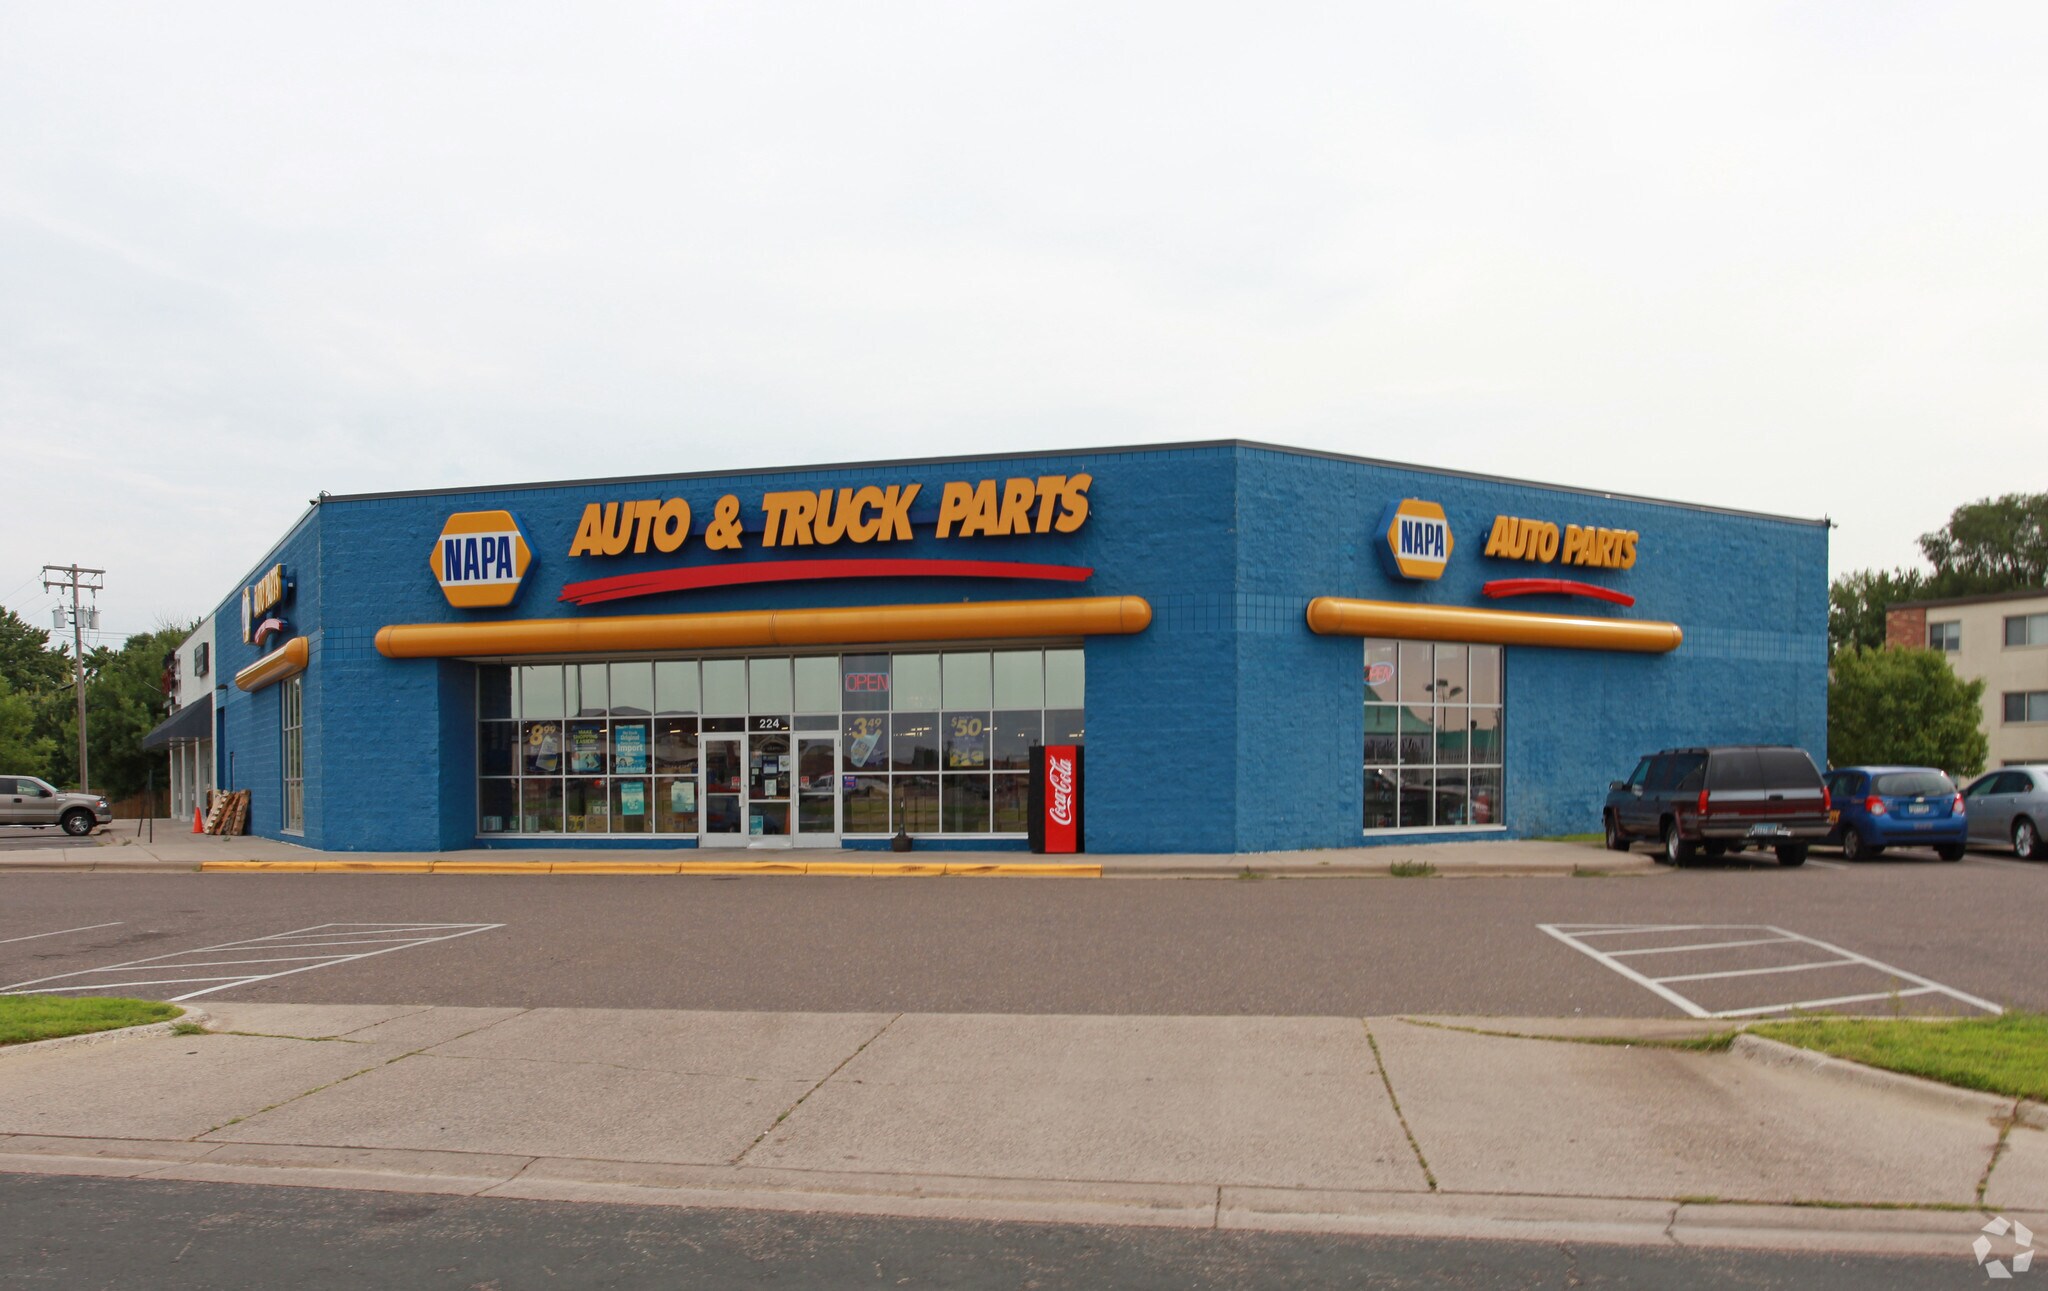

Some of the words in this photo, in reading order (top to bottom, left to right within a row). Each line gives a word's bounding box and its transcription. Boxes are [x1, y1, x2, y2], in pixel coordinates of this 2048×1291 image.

[568, 497, 691, 557] AUTO
[704, 494, 743, 550] &
[761, 484, 923, 547] TRUCK
[935, 473, 1093, 539] PARTS
[1401, 520, 1444, 557] NAPA
[1485, 515, 1560, 563] AUTO
[1561, 524, 1639, 570] PARTS
[445, 535, 513, 582] NAPA
[846, 674, 889, 691] OPEN
[1364, 664, 1392, 682] OPEN
[759, 718, 779, 729] 224
[951, 716, 982, 737] $50
[620, 734, 640, 742] Original
[617, 743, 643, 753] Import
